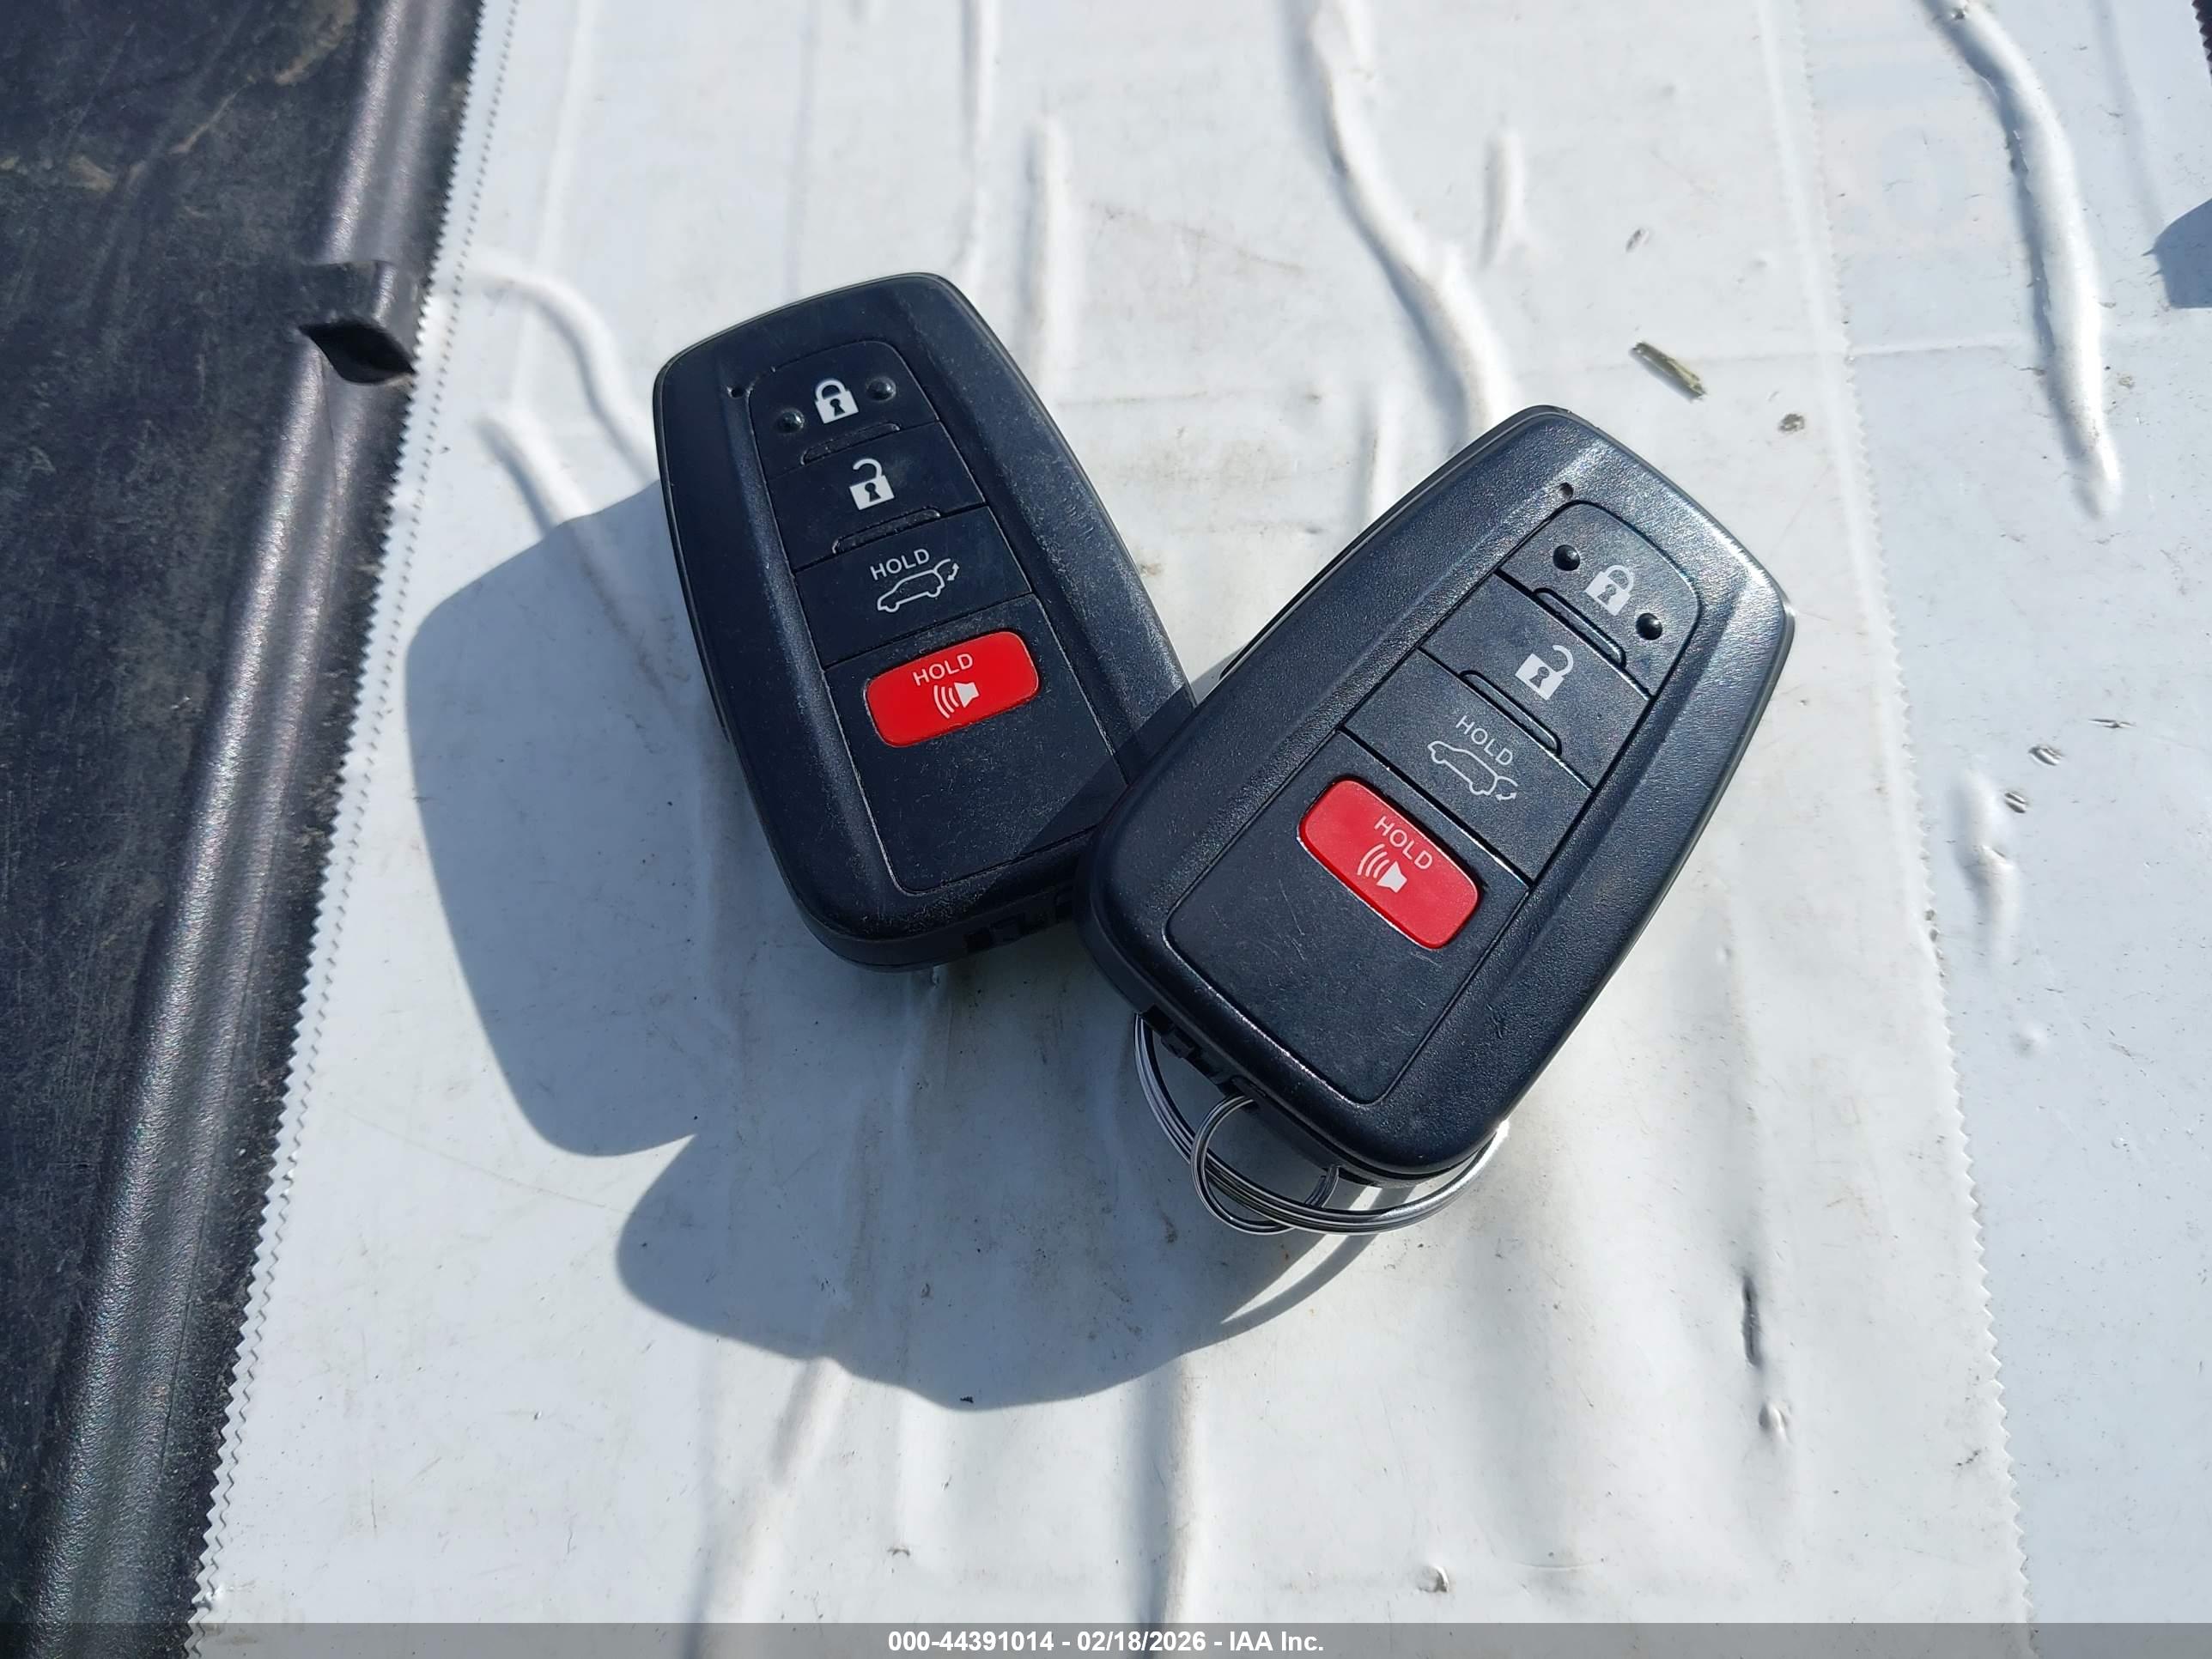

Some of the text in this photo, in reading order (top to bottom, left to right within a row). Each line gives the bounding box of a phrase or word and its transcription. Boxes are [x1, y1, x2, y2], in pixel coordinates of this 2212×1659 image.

[870, 548, 931, 581] HOLD
[913, 653, 974, 687] HOLD
[1455, 715, 1514, 766] HOLD
[1374, 816, 1433, 870] HOLD
